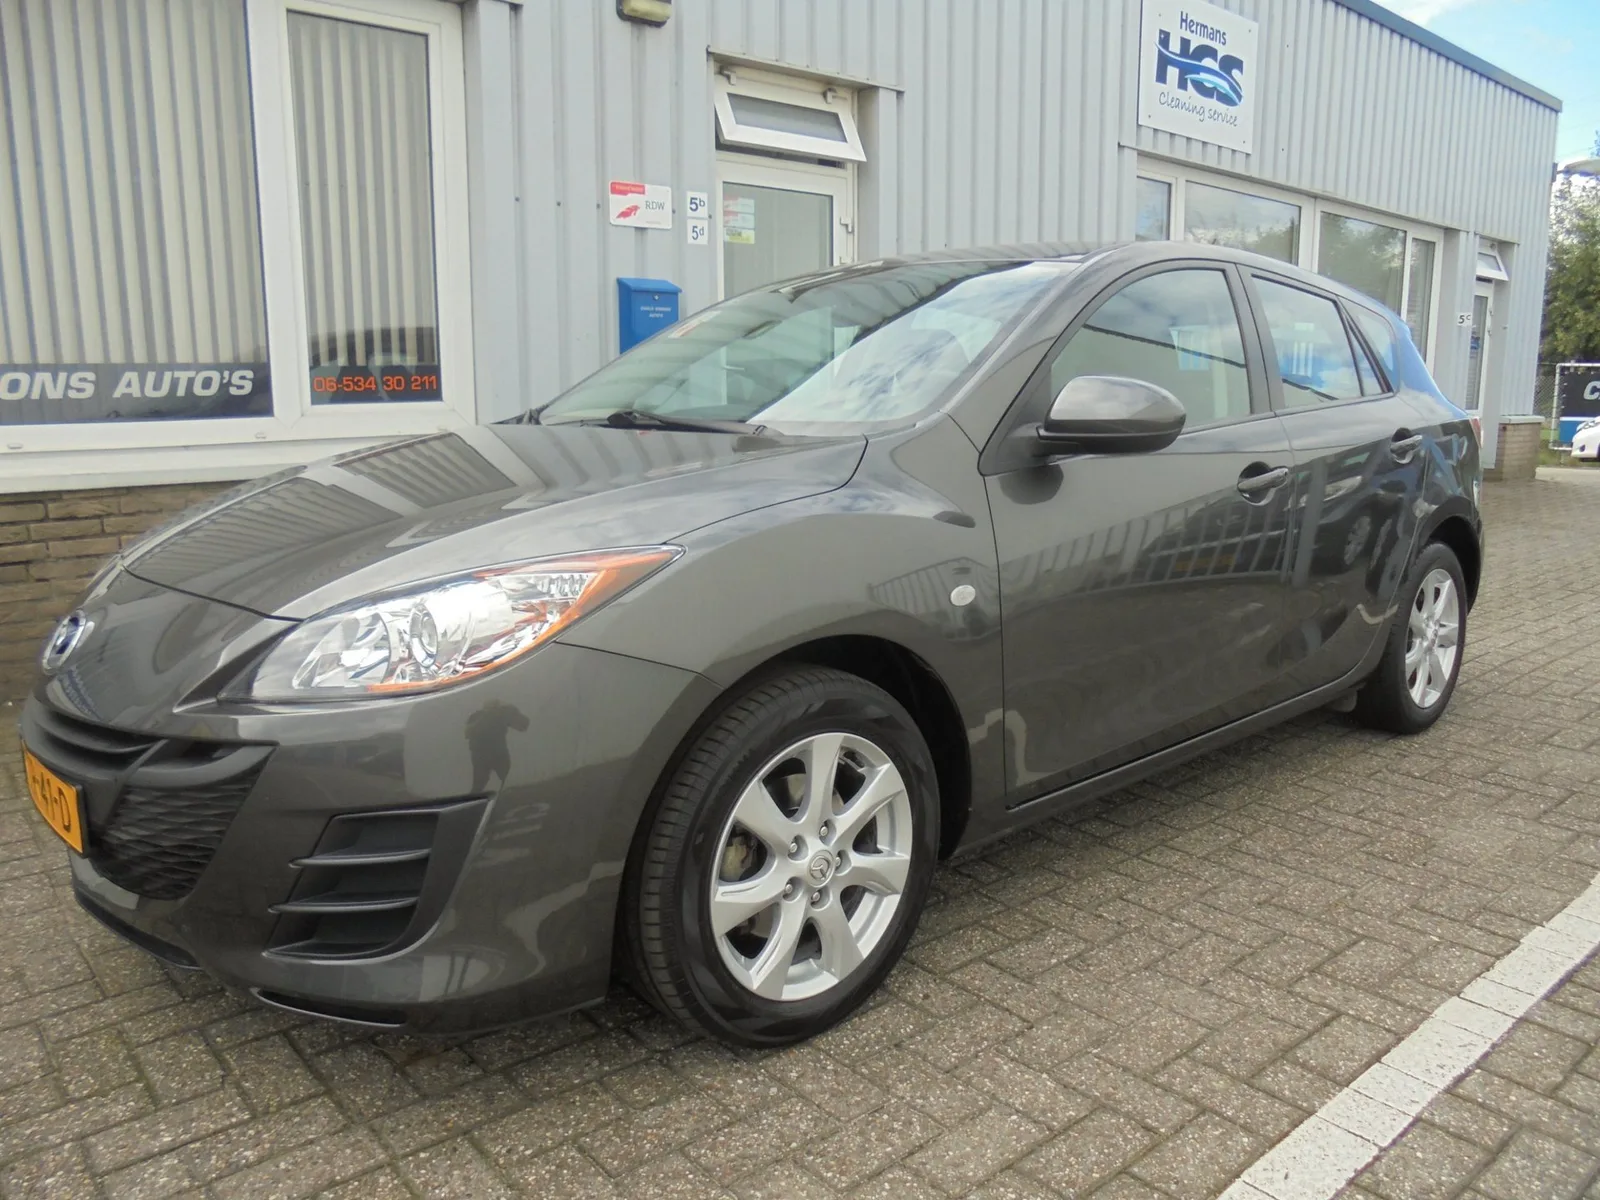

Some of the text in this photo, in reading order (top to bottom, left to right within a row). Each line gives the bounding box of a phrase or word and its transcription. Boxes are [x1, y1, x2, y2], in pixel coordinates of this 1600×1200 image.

[1179, 11, 1227, 46] Hermans
[1158, 91, 1238, 127] Cleaning service
[645, 201, 665, 210] RDW
[0, 370, 254, 400] ONS AUTO'S
[313, 375, 437, 392] 06-534 30 211
